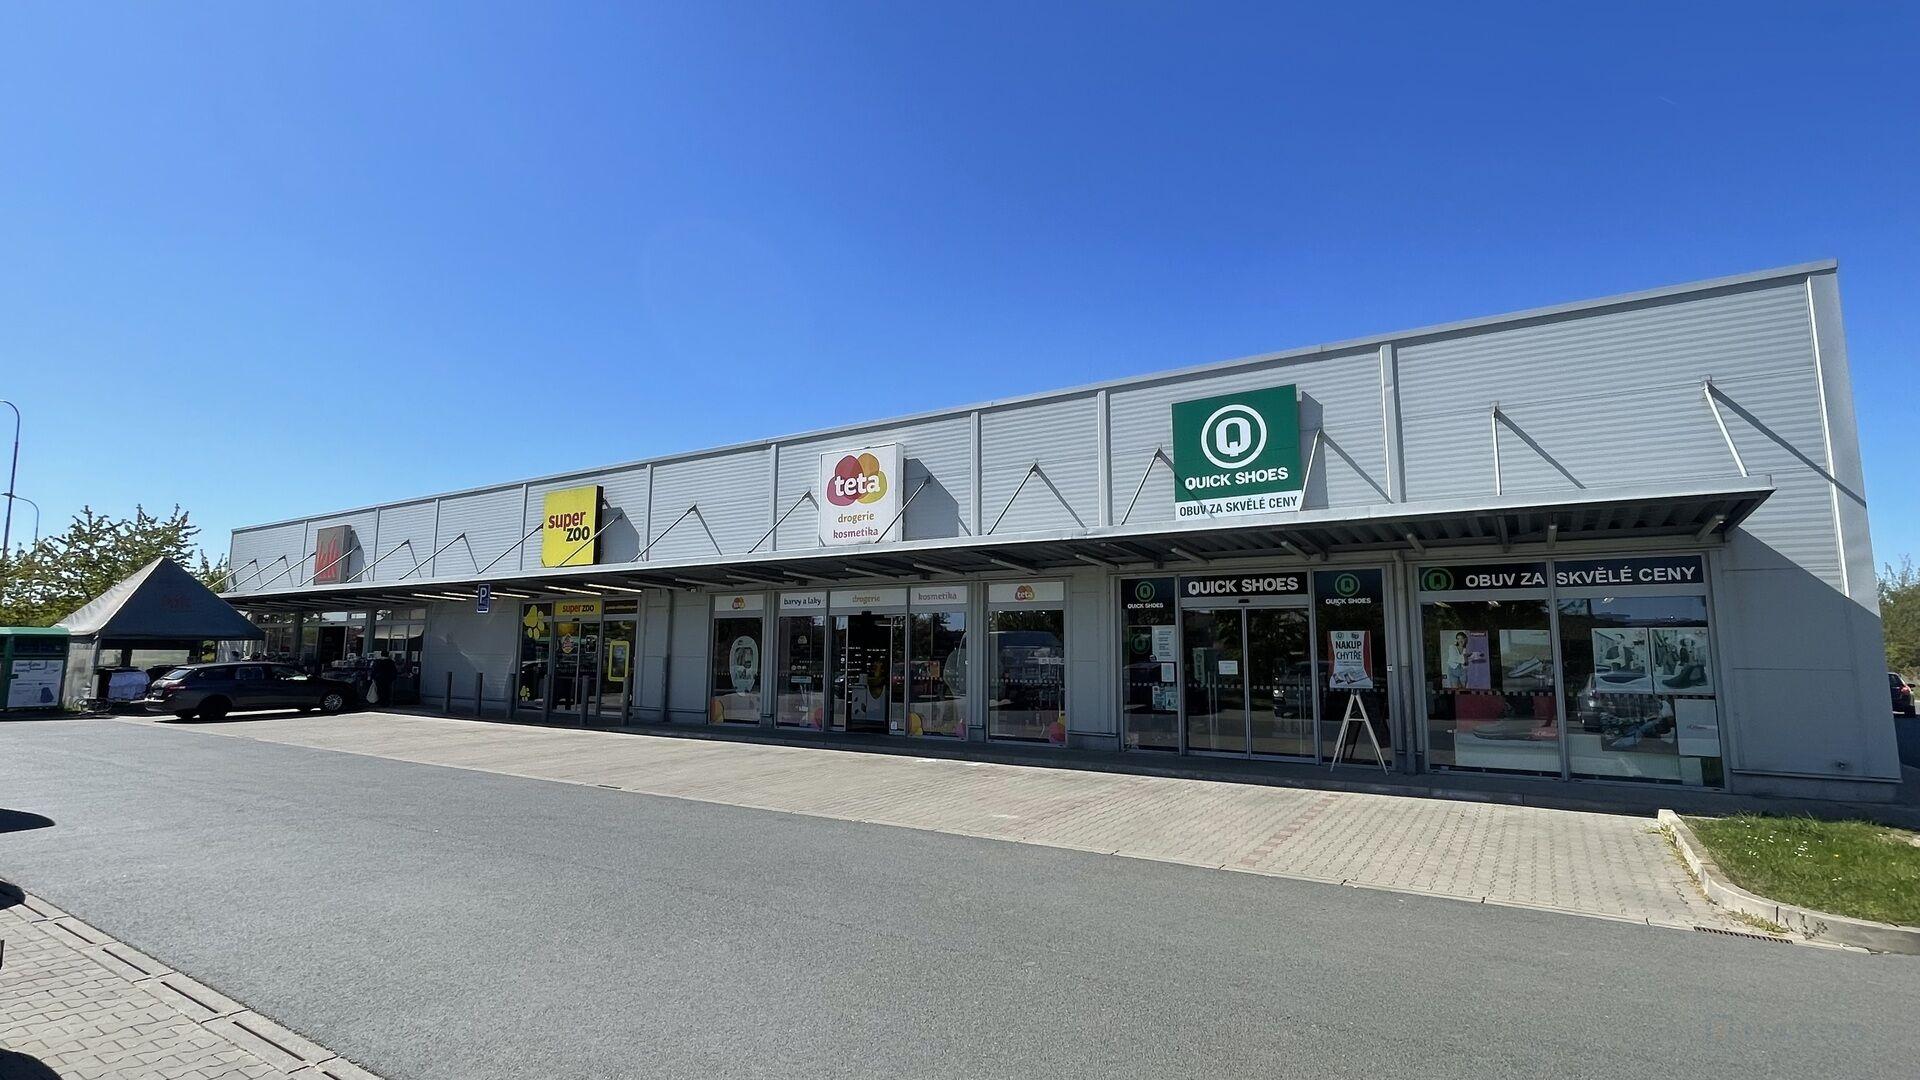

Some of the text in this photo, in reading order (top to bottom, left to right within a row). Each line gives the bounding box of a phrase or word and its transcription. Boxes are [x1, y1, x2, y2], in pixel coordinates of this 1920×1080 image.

[1216, 417, 1251, 457] Q
[834, 473, 880, 496] teta
[1185, 467, 1289, 490] QUICK SHOES
[1180, 496, 1298, 517] OBUV ZA SKVĚLÉ CENY
[548, 511, 586, 531] super
[837, 511, 875, 525] drogerie
[565, 526, 590, 542] zoo
[833, 527, 879, 539] kosmetika
[1465, 566, 1696, 587] OBUV ZA SKVĚLÉ CENY
[1188, 577, 1299, 595] QUICK SHOES
[480, 587, 487, 604] P
[784, 598, 801, 606] barvy
[807, 596, 822, 606] laky
[852, 594, 880, 605] drogerie
[918, 592, 957, 601] kosmetika
[1016, 591, 1034, 600] teta
[562, 604, 595, 614] super zoo
[1336, 650, 1362, 660] CHYTŘE
